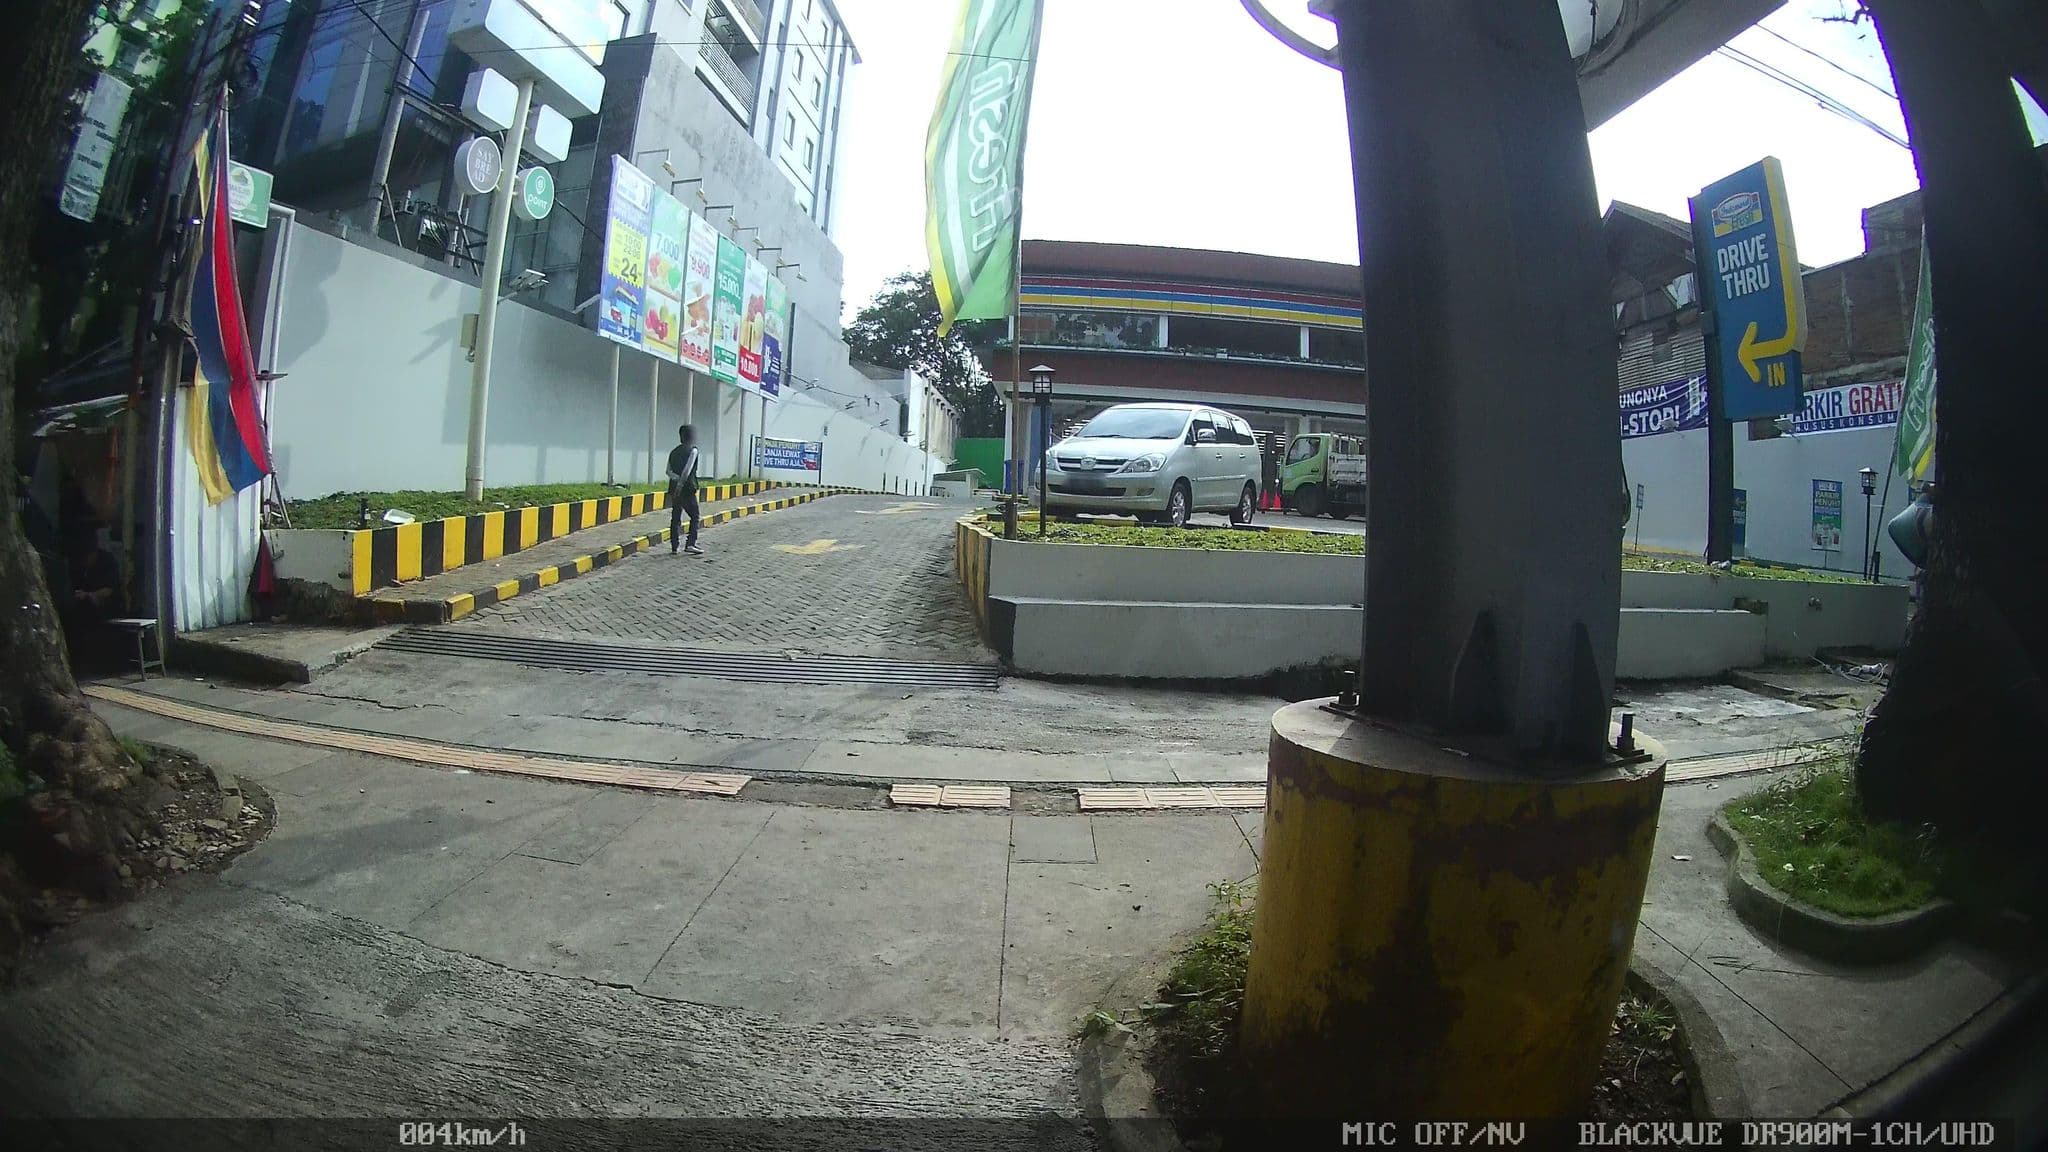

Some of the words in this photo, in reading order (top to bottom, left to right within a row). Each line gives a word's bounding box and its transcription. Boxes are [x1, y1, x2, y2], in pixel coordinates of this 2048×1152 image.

[1716, 233, 1769, 274] DRIVE
[620, 258, 638, 282] 24
[1722, 262, 1771, 300] THRU
[1767, 361, 1786, 387] IN
[1620, 404, 1680, 435] -STOP!
[1792, 391, 1843, 423] RKIR
[1795, 419, 1835, 433] HUSUS
